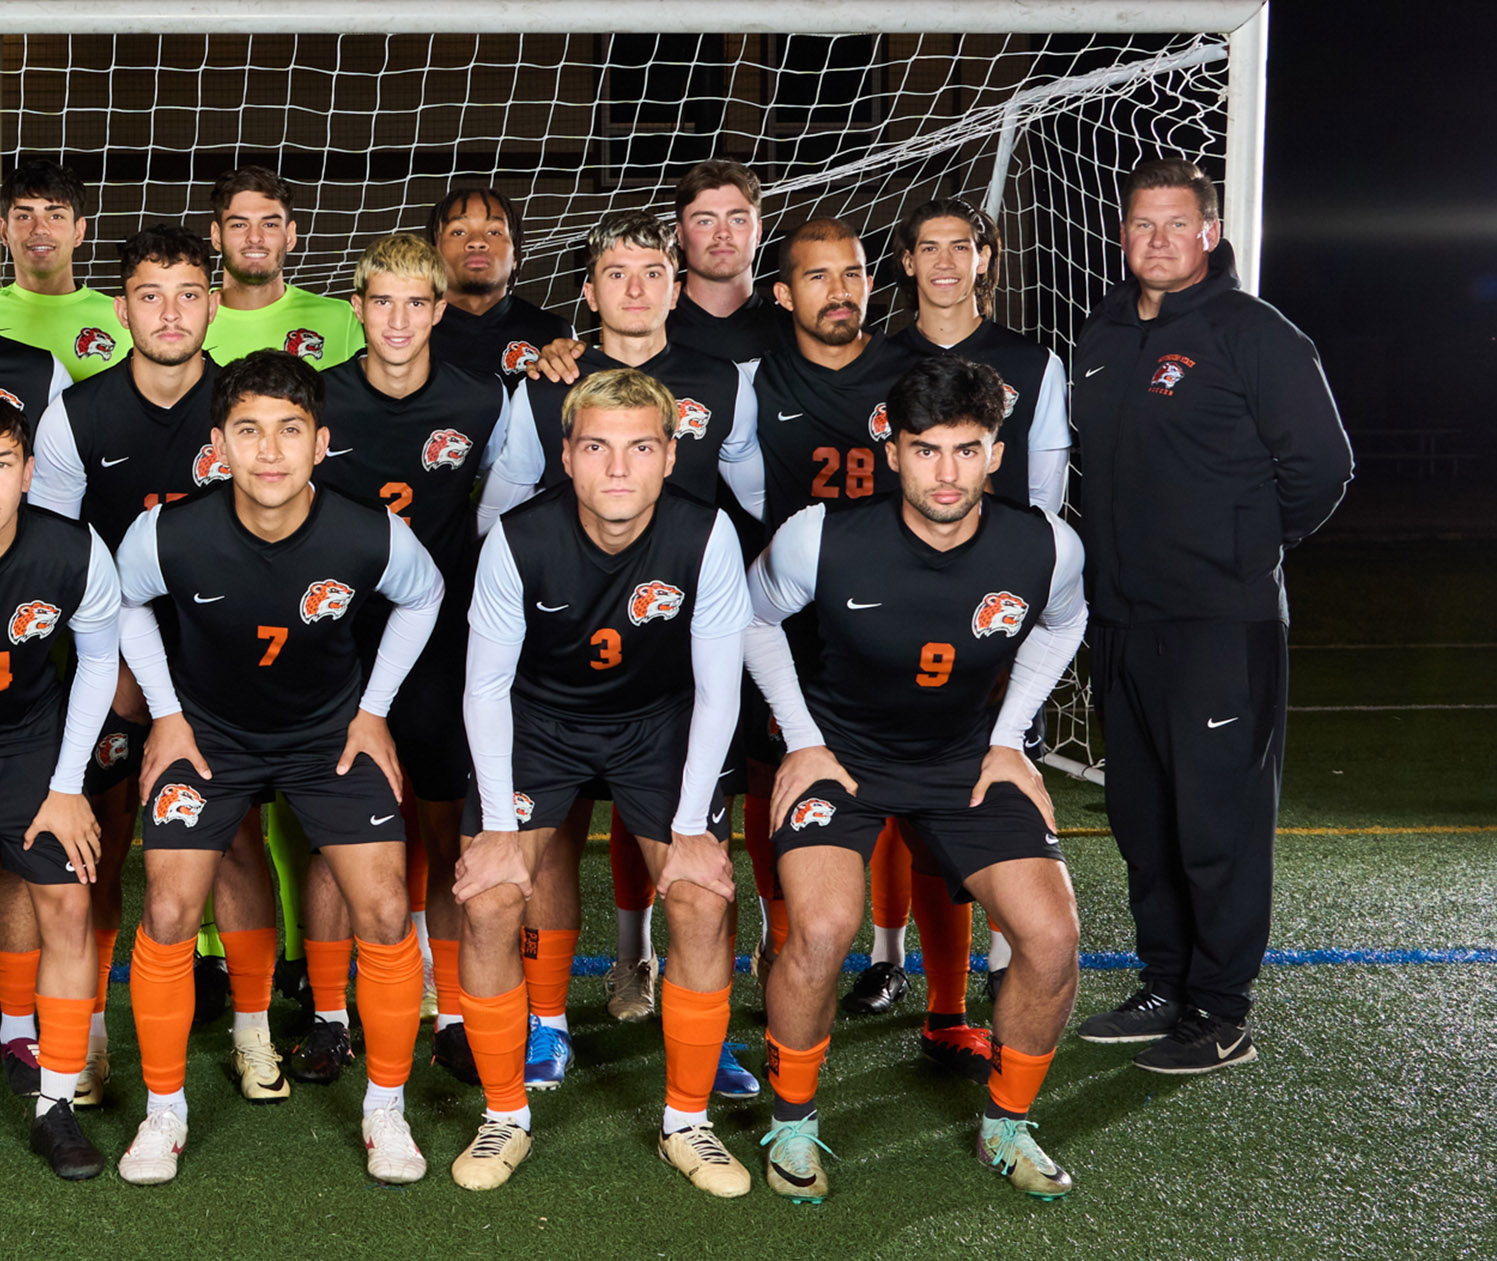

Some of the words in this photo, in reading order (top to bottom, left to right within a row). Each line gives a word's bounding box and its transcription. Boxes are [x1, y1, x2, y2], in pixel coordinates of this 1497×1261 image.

[812, 447, 874, 499] 28
[379, 481, 413, 528] 2
[257, 626, 288, 667] 7
[591, 628, 622, 670] 3
[916, 642, 956, 687] 9
